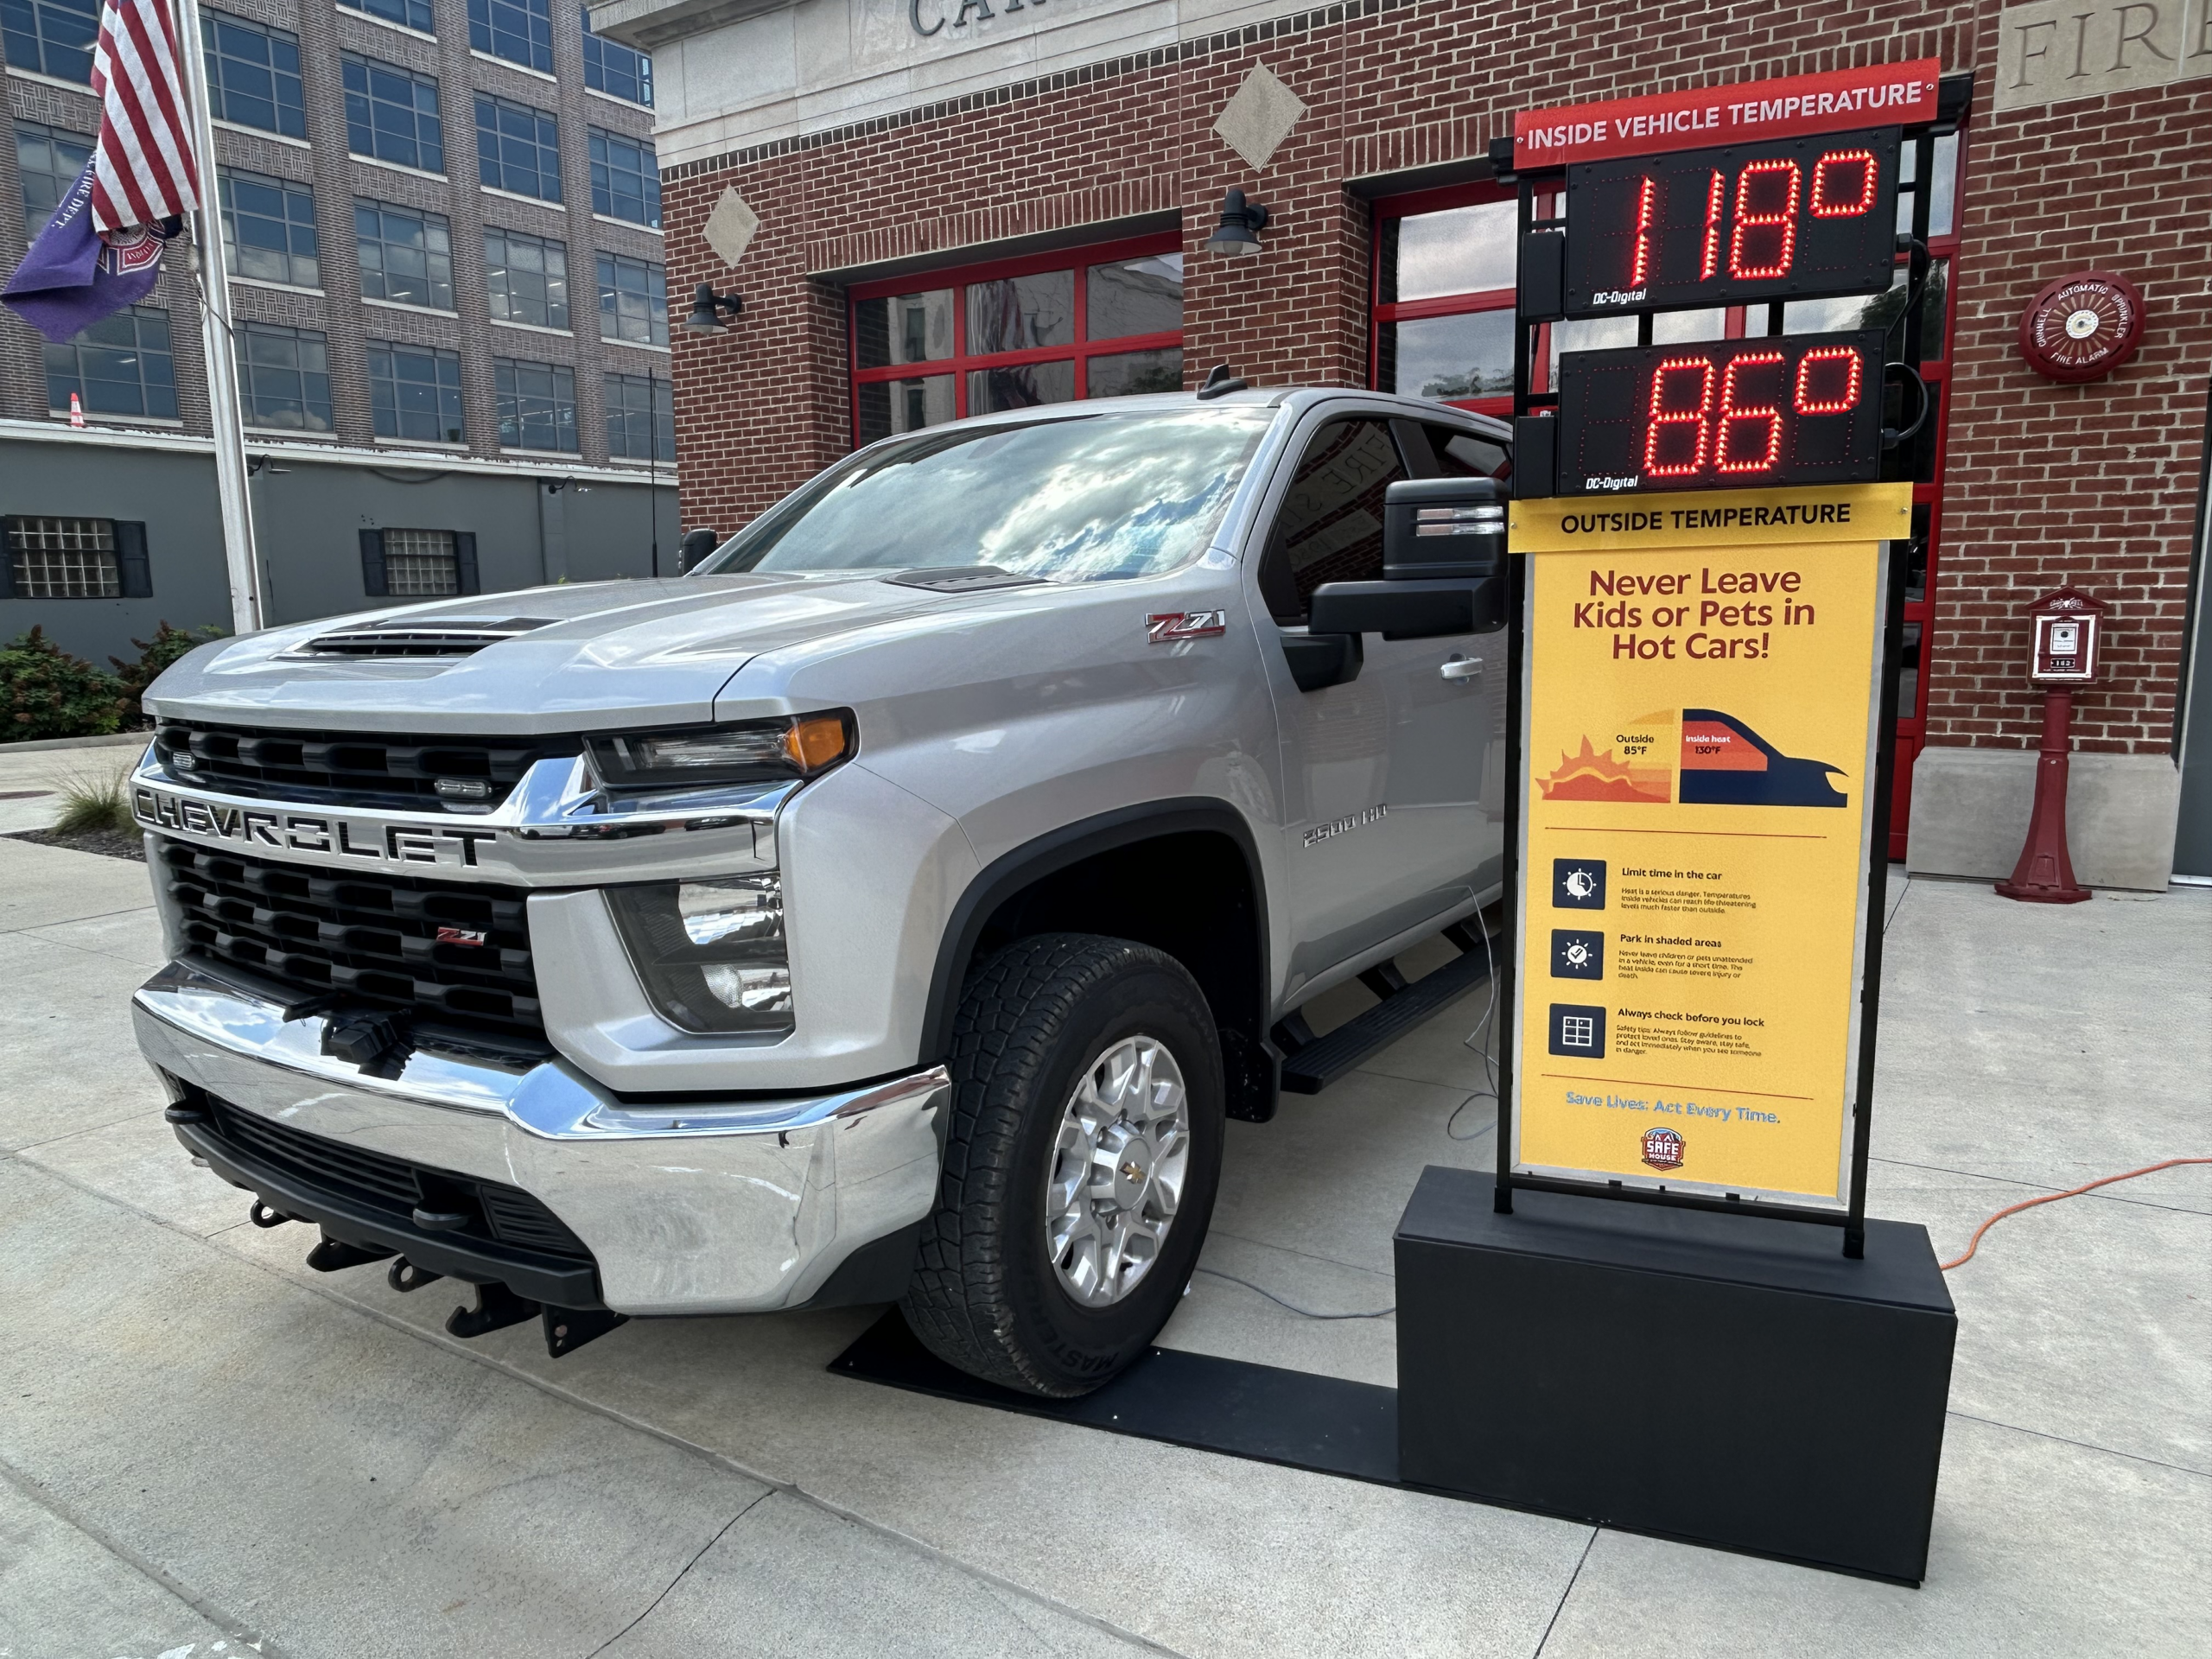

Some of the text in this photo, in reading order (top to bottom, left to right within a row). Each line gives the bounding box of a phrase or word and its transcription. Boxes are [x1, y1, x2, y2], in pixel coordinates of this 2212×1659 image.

[1528, 80, 1923, 149] INSIDE VEHICLE TEMPERATURE
[1592, 288, 1647, 306] DC-Digital
[1586, 475, 1638, 491] DC-Digital
[1561, 503, 1852, 534] OUTSIDE TEMPERATURE
[1590, 568, 1801, 596] Never Leave
[1573, 598, 1815, 628] Kids or Pets in
[1145, 609, 1225, 644] Z71
[1612, 632, 1770, 659] Hot Cars!
[1616, 734, 1655, 743] Outside
[1686, 734, 1710, 743] Inside
[1624, 746, 1647, 755] 85°F
[136, 788, 498, 868] CHEVROLET
[1622, 868, 1647, 877] Limit
[1649, 868, 1672, 878] time
[1675, 869, 1684, 879] in
[1687, 870, 1704, 880] the
[1620, 934, 1722, 948] Park in shaded areas
[1618, 1008, 1765, 1027] Always check before you lock
[1566, 1091, 1602, 1106] Save
[1654, 1100, 1681, 1115] Act
[1687, 1103, 1732, 1122] Every
[1736, 1107, 1781, 1123] Time.
[1646, 1141, 1679, 1155] SAFE
[1649, 1153, 1677, 1161] HOUSE
